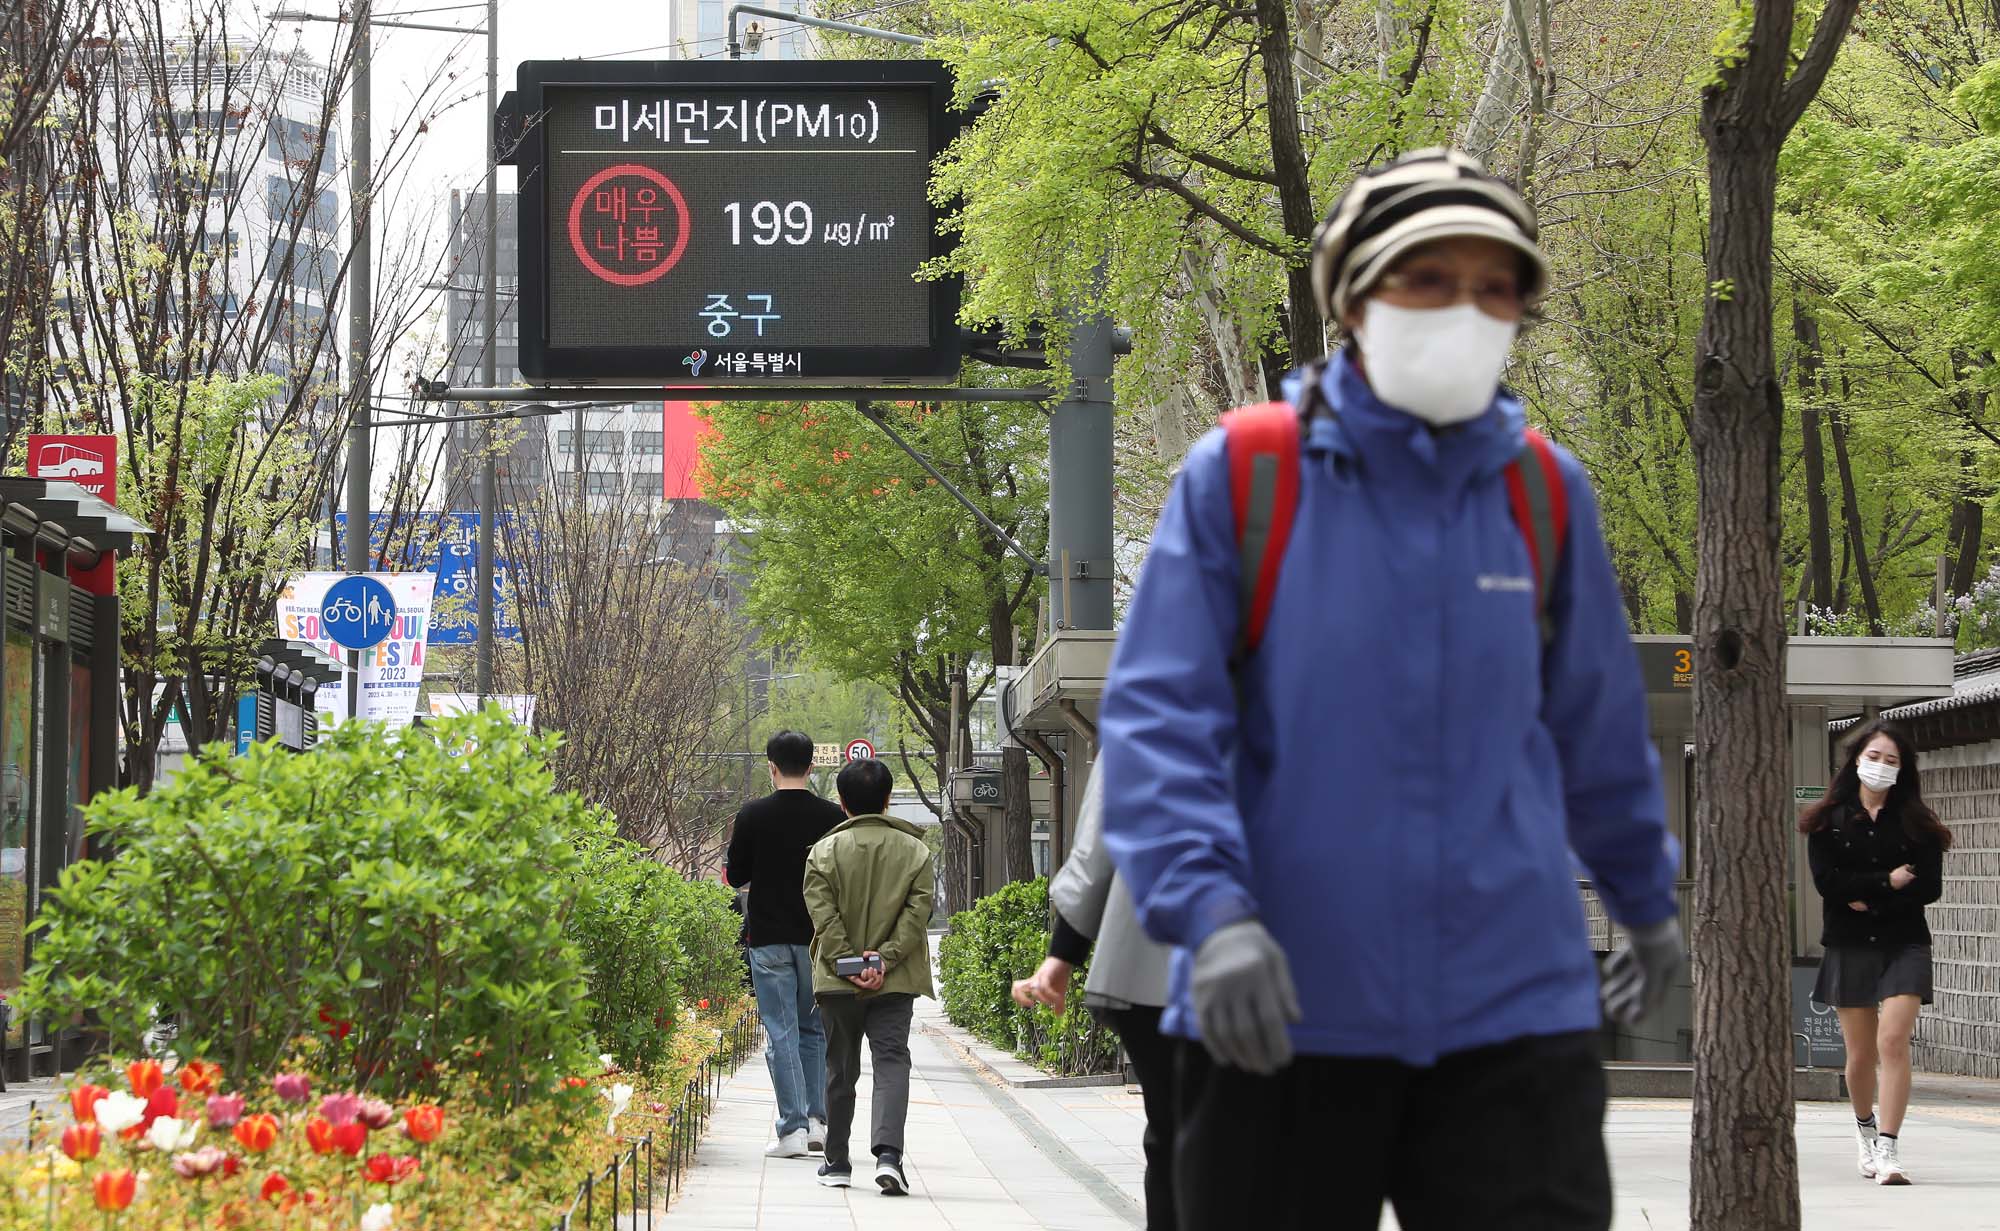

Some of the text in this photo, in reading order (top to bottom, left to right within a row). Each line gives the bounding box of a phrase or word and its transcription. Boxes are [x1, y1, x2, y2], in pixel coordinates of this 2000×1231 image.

[594, 99, 880, 144] 미세먼지(PM10)
[595, 186, 664, 224] 매우
[723, 200, 813, 246] 199
[595, 226, 664, 263] 나쁨
[698, 294, 781, 338] 중구
[714, 351, 802, 373] 서울특별시
[380, 667, 406, 680] 2023
[1674, 649, 1691, 673] 3
[852, 746, 869, 760] 50
